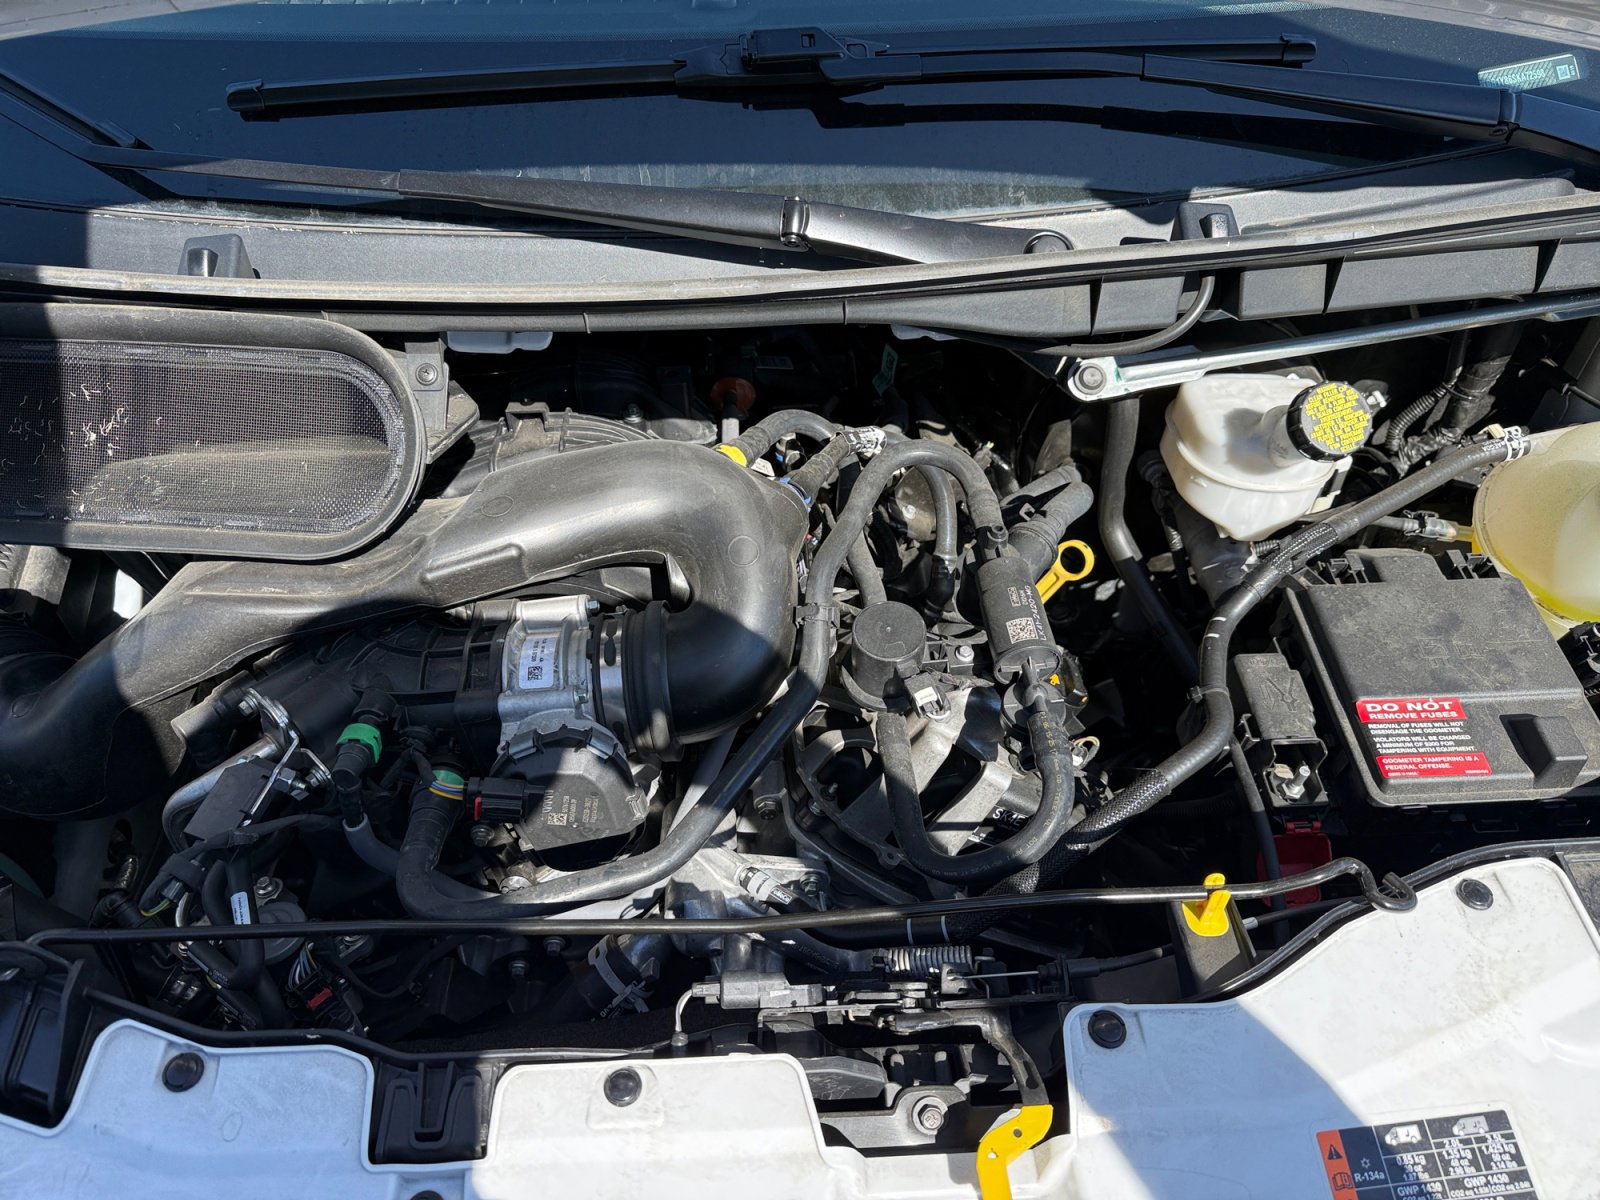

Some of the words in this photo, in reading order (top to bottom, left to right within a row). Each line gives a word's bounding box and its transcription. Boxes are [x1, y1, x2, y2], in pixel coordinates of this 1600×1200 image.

[1365, 703, 1399, 712] DO
[1406, 701, 1452, 711] NOT
[1368, 712, 1418, 720] REMOVE
[1486, 1134, 1506, 1143] 3.5L
[1444, 1140, 1464, 1148] 2.0L
[1482, 1143, 1504, 1154] 1.425
[1504, 1142, 1516, 1154] kg
[1442, 1148, 1460, 1160] 1.35
[1460, 1148, 1472, 1160] kg
[1396, 1155, 1414, 1166] 0.85
[1414, 1153, 1426, 1165] kg
[1464, 1166, 1476, 1174] lbs
[1490, 1161, 1506, 1170] 3.14
[1506, 1160, 1518, 1168] lbs
[1354, 1171, 1385, 1182] R-134a
[1418, 1172, 1430, 1180] lbs
[1464, 1176, 1486, 1188] GWP
[1488, 1173, 1510, 1184] 1430
[1397, 1185, 1418, 1196] GWP
[1421, 1182, 1442, 1194] 1430
[1492, 1184, 1506, 1192] CO2
[1450, 1189, 1464, 1198] CO2
[1466, 1189, 1474, 1198] eq
